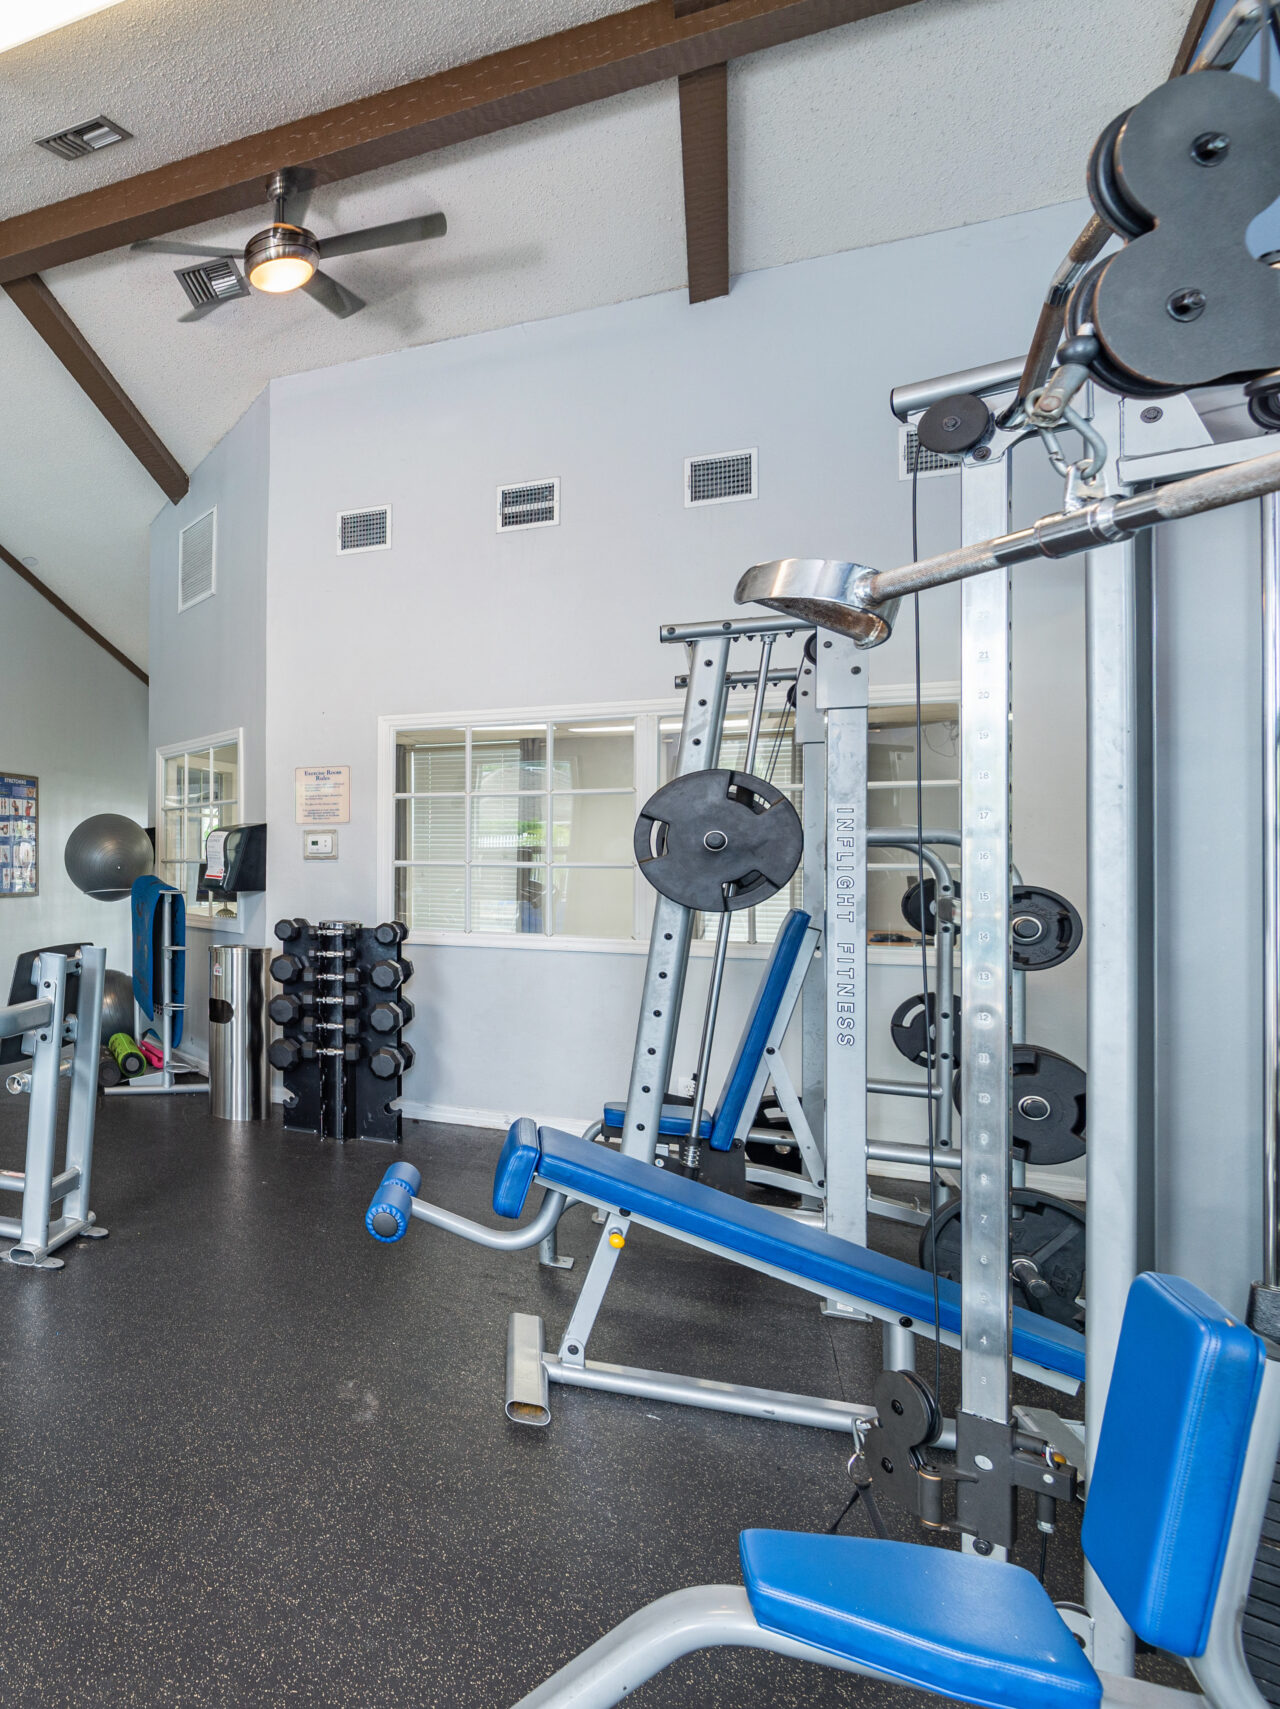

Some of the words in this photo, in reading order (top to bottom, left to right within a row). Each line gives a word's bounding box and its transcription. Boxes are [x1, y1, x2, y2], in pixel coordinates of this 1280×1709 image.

[978, 651, 990, 659] 21
[978, 691, 990, 699] 20
[978, 731, 989, 740] 19
[978, 772, 990, 780] 18
[979, 812, 989, 820] 17
[979, 852, 990, 860] 16
[836, 807, 855, 923] INFLIGHT
[979, 892, 990, 900] 15
[979, 972, 990, 981] 13
[836, 942, 855, 1047] FITNESS
[978, 1014, 990, 1022] 12
[981, 1214, 988, 1223] 7
[981, 1255, 988, 1265] 6
[980, 1336, 987, 1345] 4
[981, 1376, 988, 1385] 3
